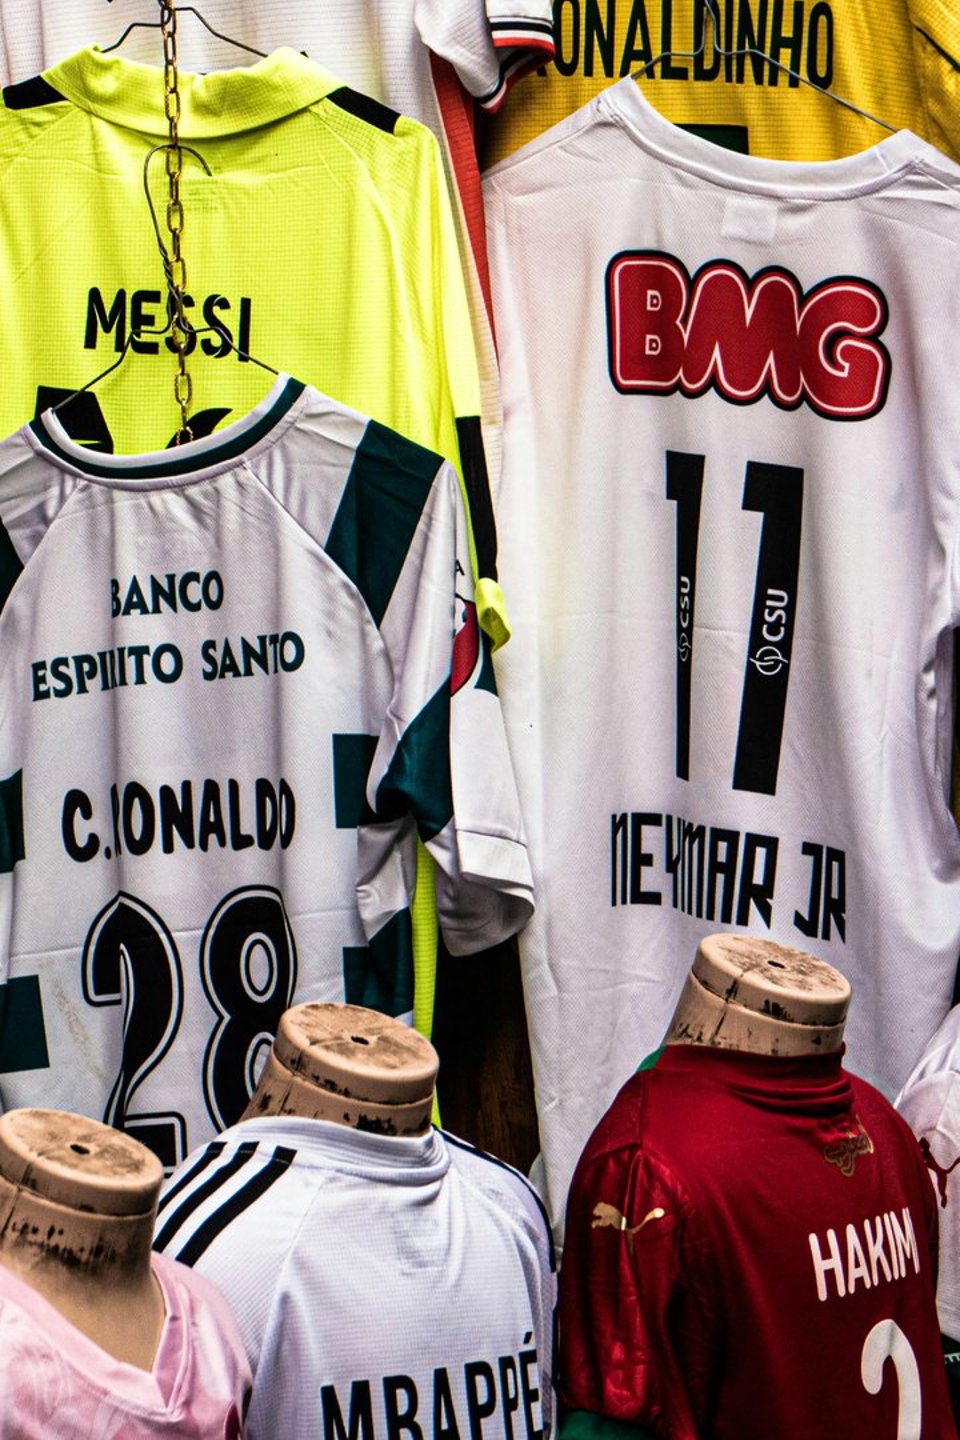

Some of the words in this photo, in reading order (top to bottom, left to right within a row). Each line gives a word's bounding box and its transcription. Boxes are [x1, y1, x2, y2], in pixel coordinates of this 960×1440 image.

[83, 286, 252, 363] MESSI
[605, 249, 892, 422] BMG
[110, 569, 225, 619] BANCO
[665, 449, 805, 797] 11
[679, 575, 691, 629] CSU
[761, 587, 789, 642] CSU
[201, 630, 306, 682] SANTO
[611, 812, 780, 930] NEYMAR
[793, 840, 847, 945] JR
[82, 884, 297, 1176] 28
